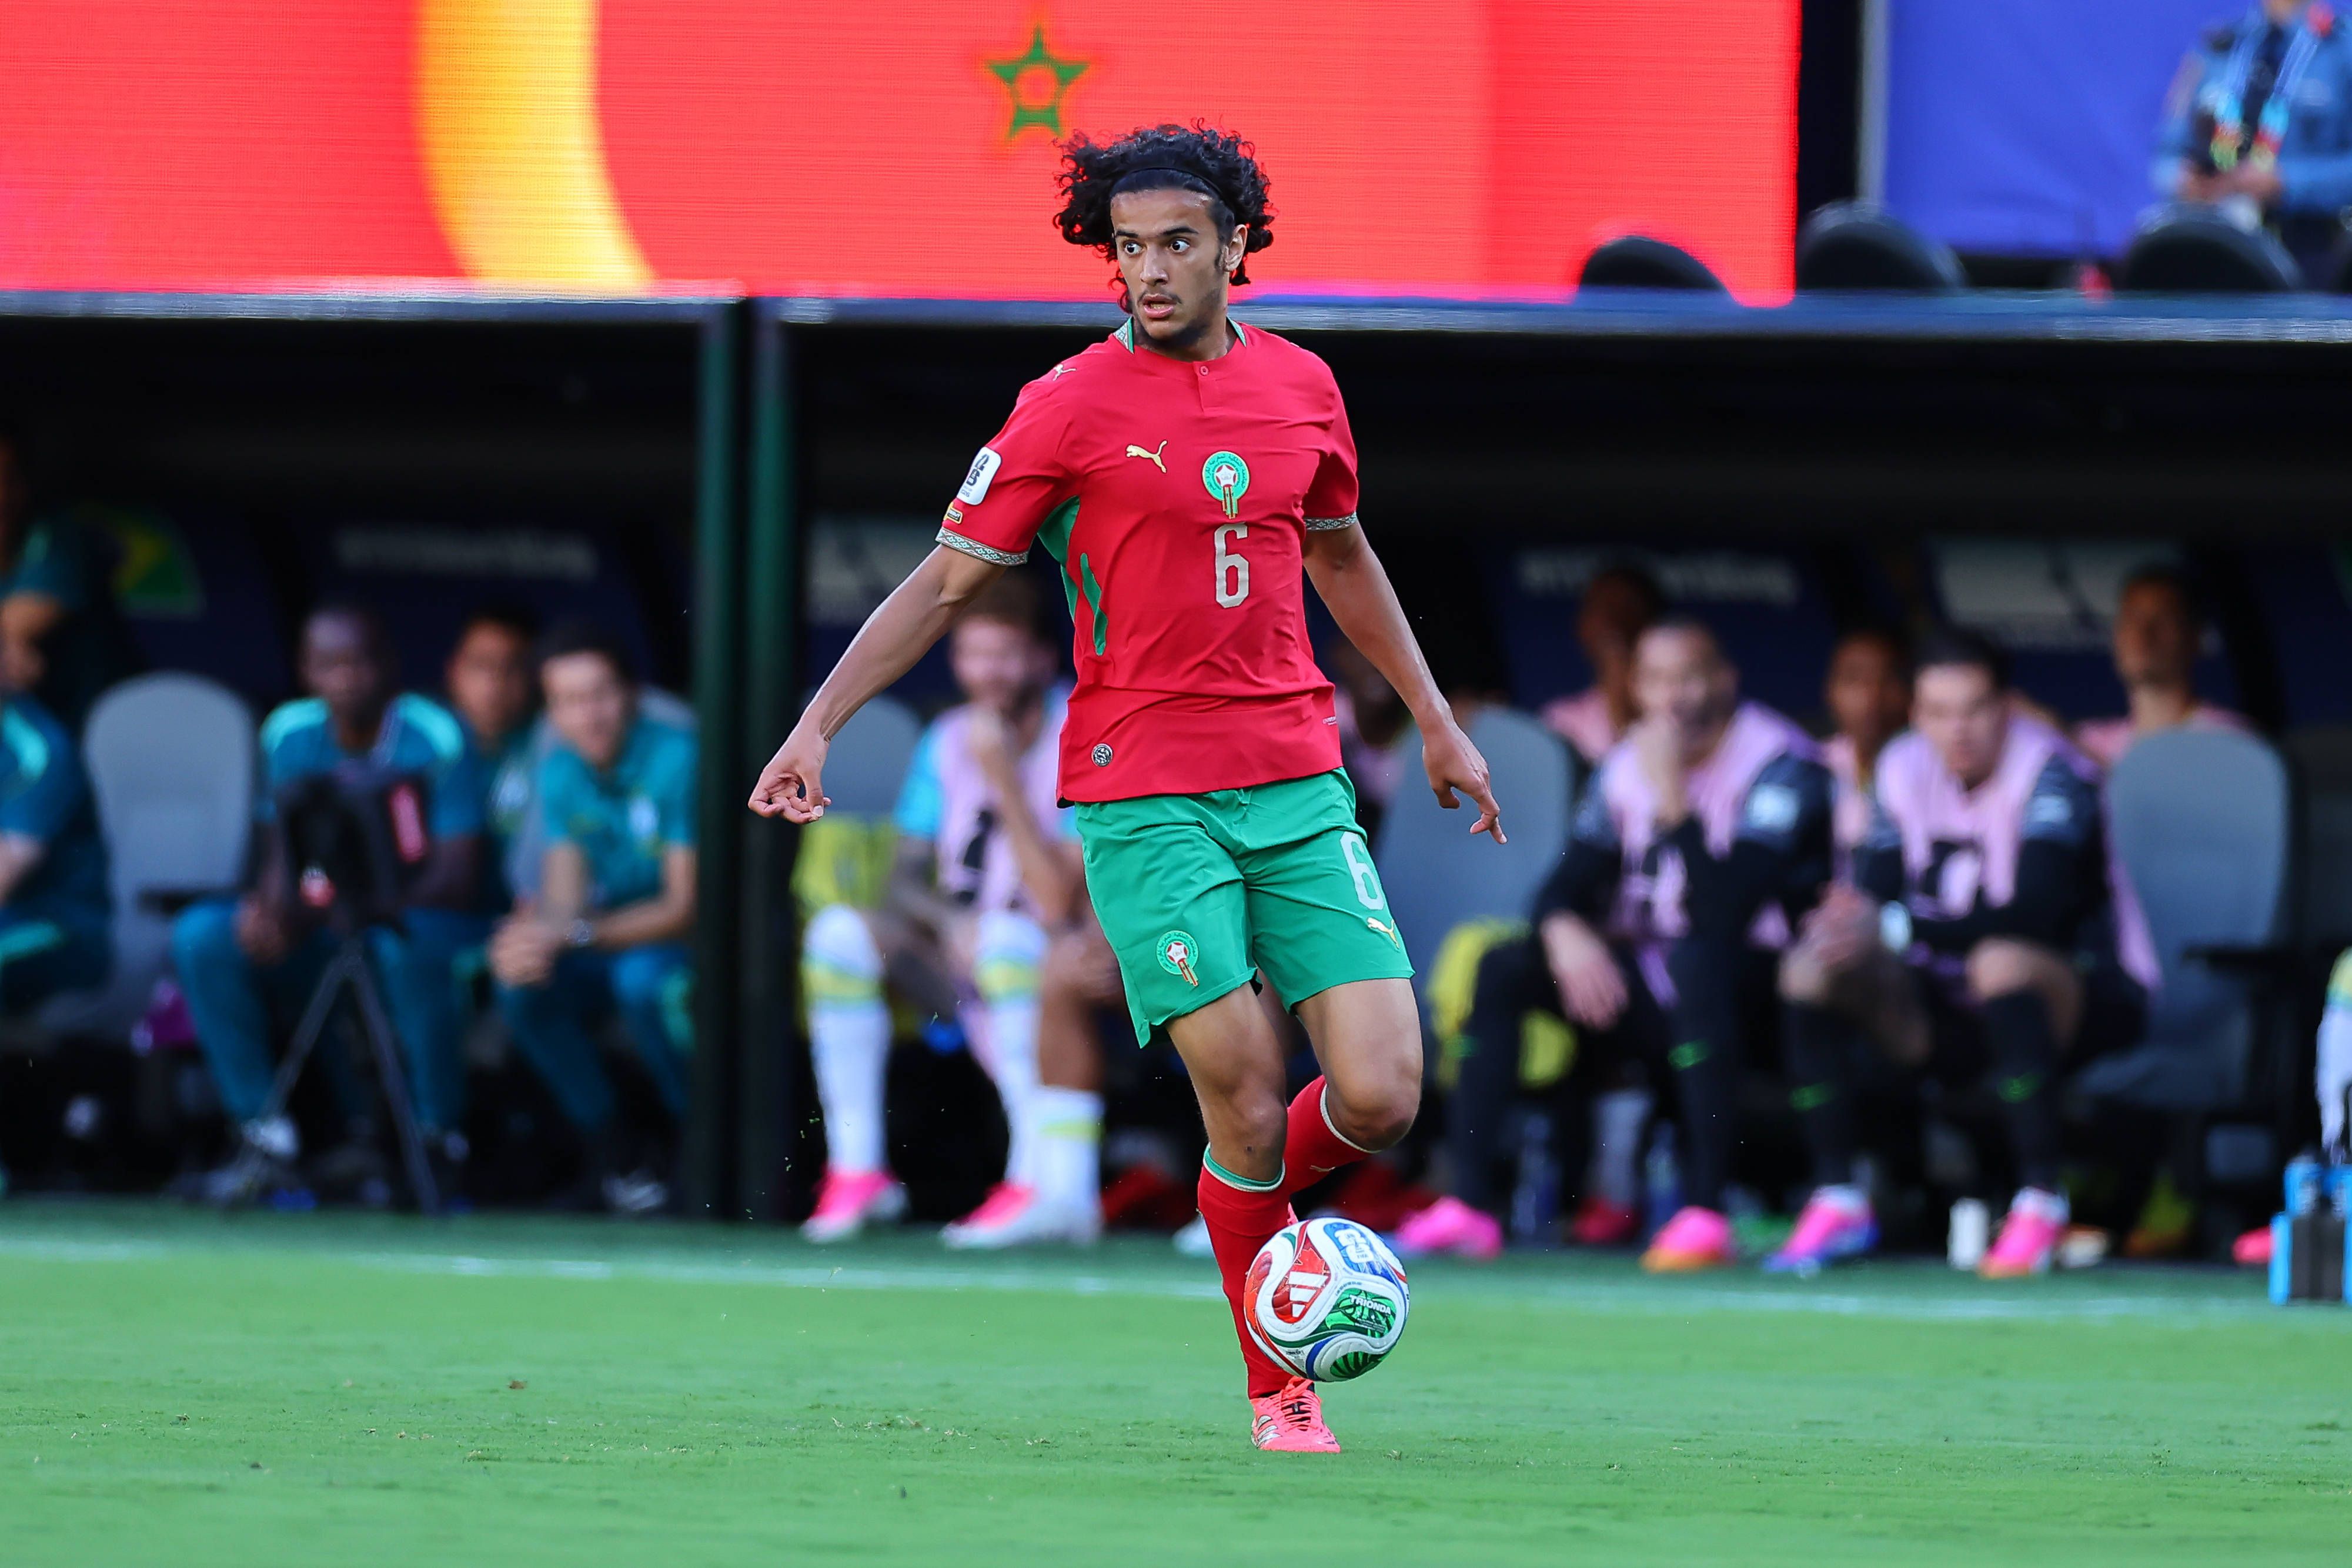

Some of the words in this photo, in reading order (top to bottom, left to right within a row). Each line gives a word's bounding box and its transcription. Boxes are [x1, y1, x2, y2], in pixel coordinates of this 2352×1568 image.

[1214, 522, 1249, 608] 6
[1340, 831, 1384, 910] 6
[1349, 1295, 1391, 1315] TRIONDA
